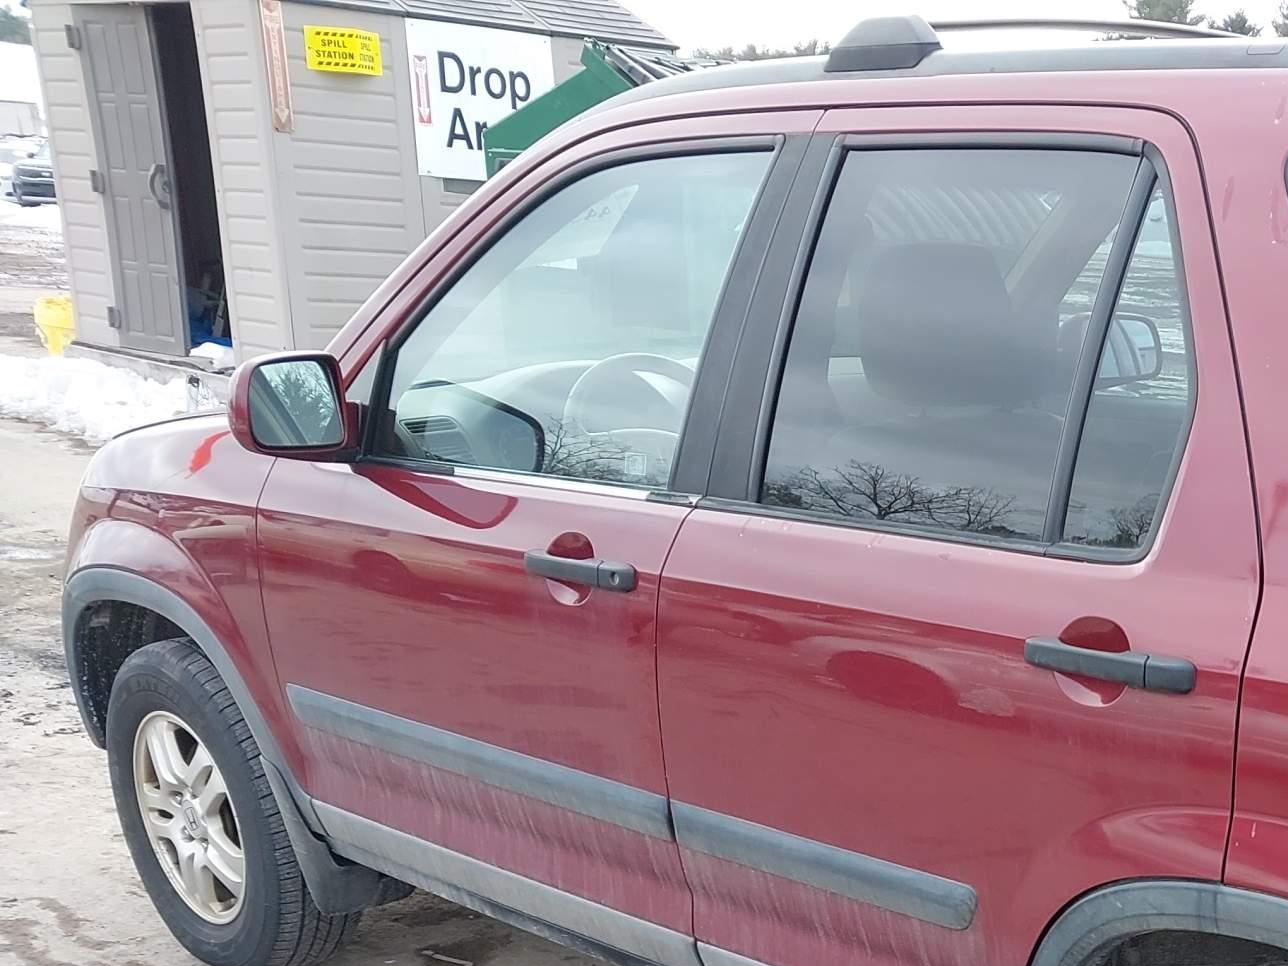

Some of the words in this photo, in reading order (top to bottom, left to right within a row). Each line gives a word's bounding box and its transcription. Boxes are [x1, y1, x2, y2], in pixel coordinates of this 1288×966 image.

[320, 38, 348, 49] SPILL
[315, 49, 354, 60] STATION
[437, 50, 531, 110] Drop
